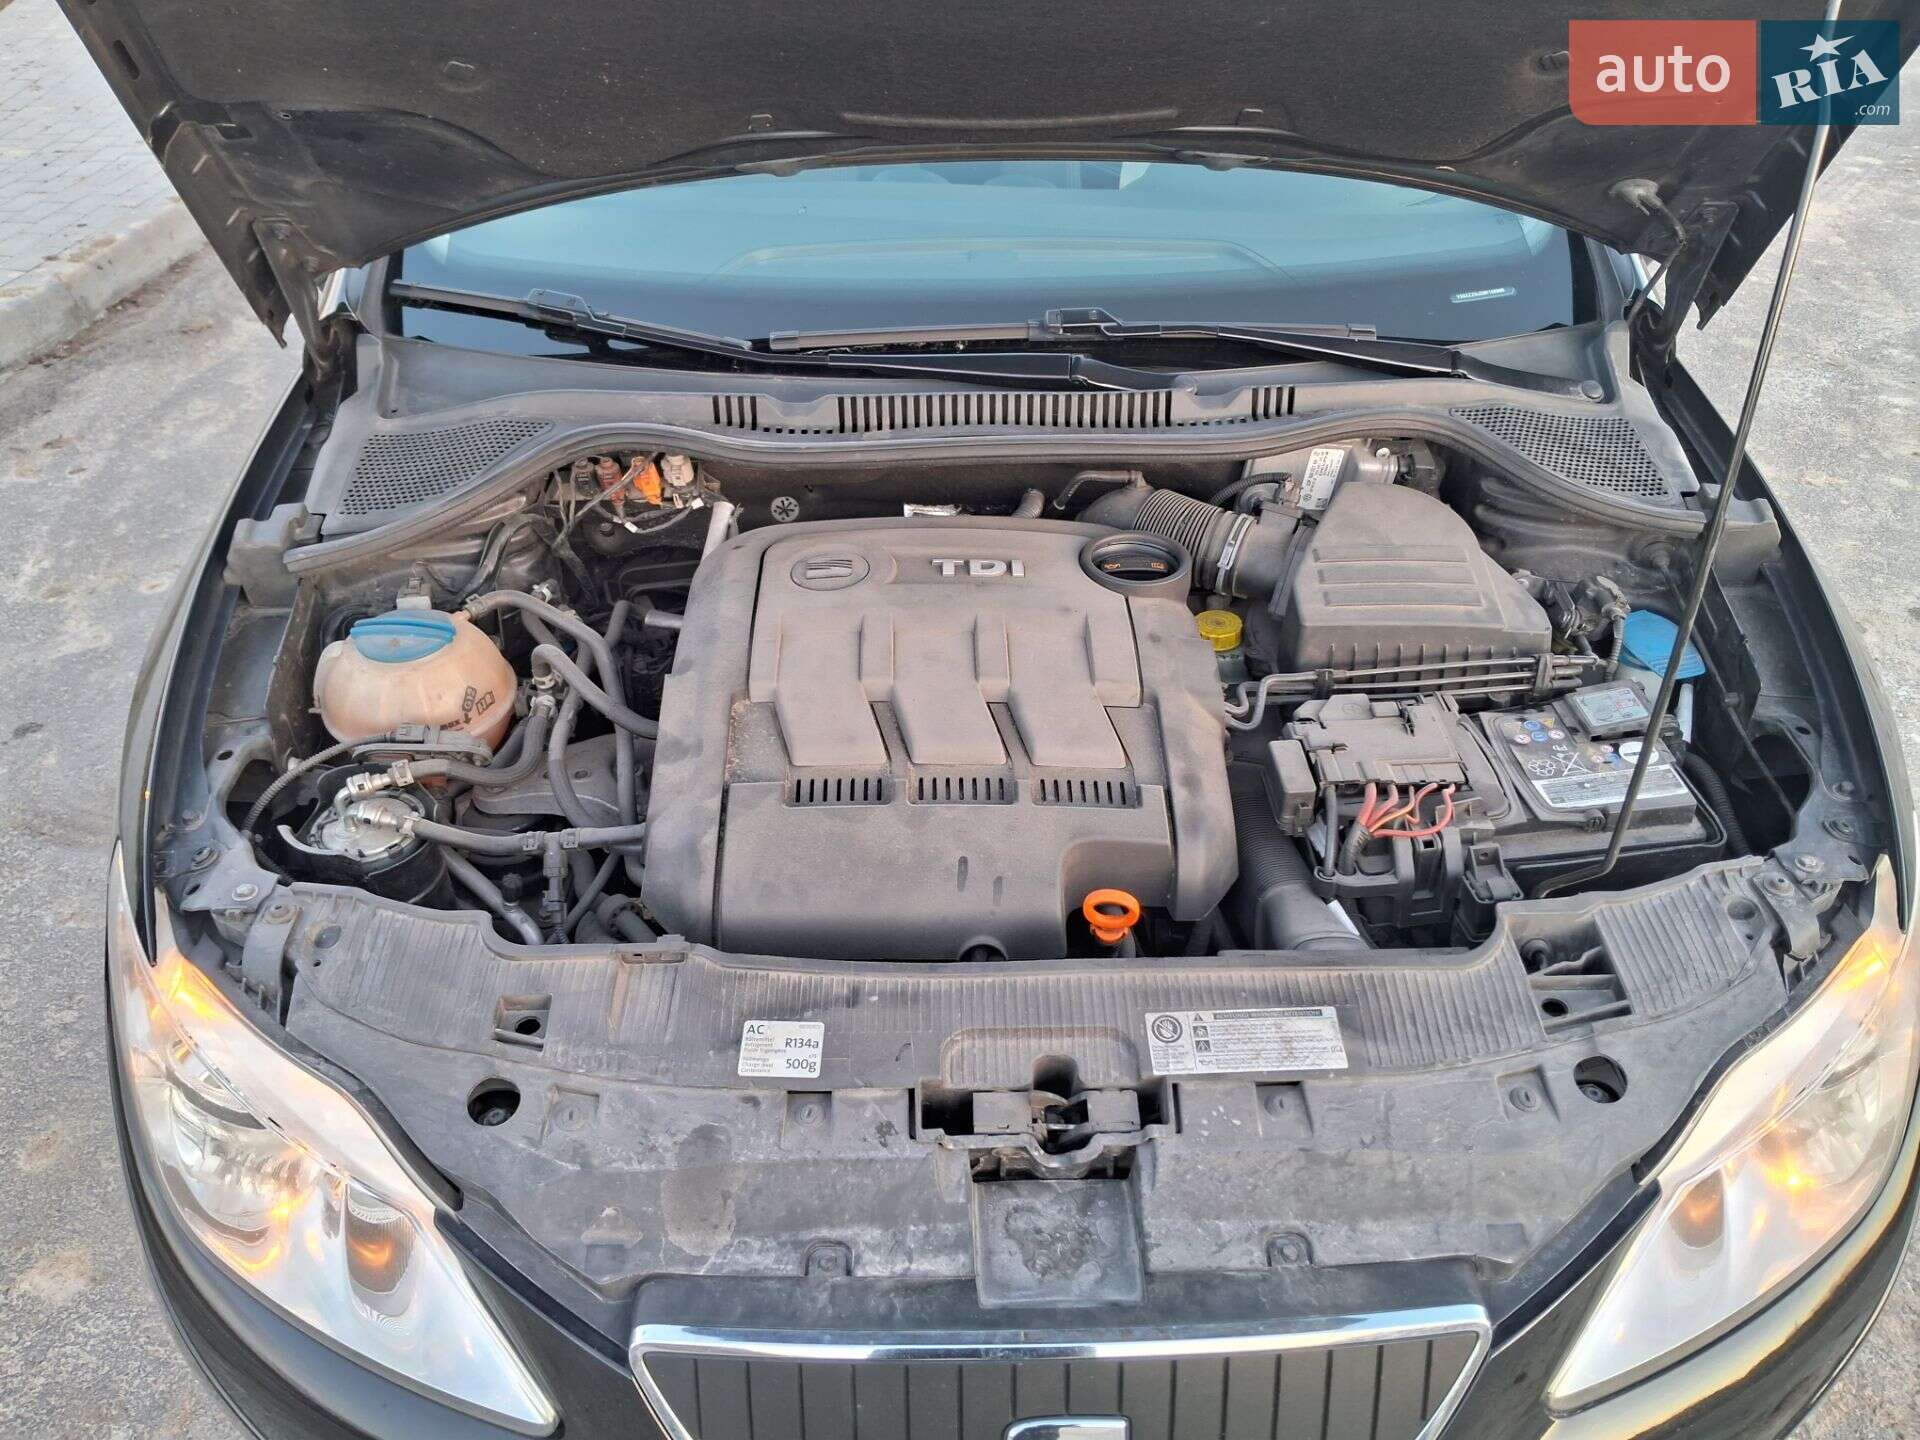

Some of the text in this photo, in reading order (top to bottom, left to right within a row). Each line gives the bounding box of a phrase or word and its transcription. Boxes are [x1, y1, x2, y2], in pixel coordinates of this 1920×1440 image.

[931, 558, 1026, 577] TDI
[746, 1024, 765, 1035] AC
[785, 1037, 819, 1049] R134a
[785, 1058, 817, 1073] 500g
